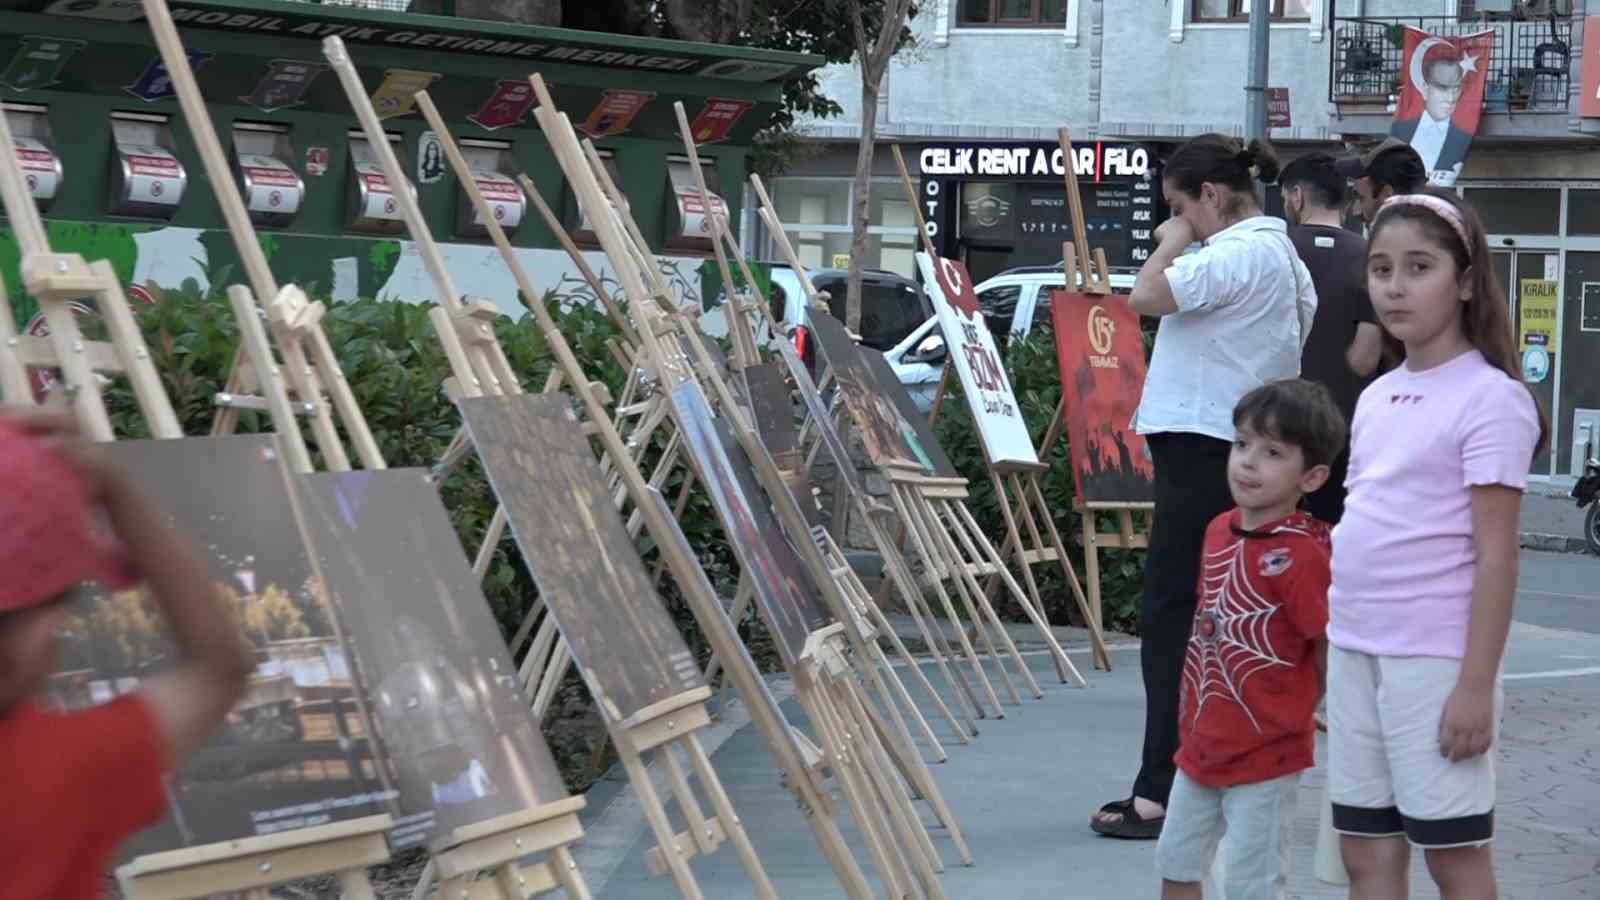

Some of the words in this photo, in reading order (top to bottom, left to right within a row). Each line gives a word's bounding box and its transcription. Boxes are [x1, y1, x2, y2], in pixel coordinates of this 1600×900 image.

[977, 148, 1031, 175] RENT
[1032, 148, 1049, 175] A
[925, 180, 940, 237] OTO
